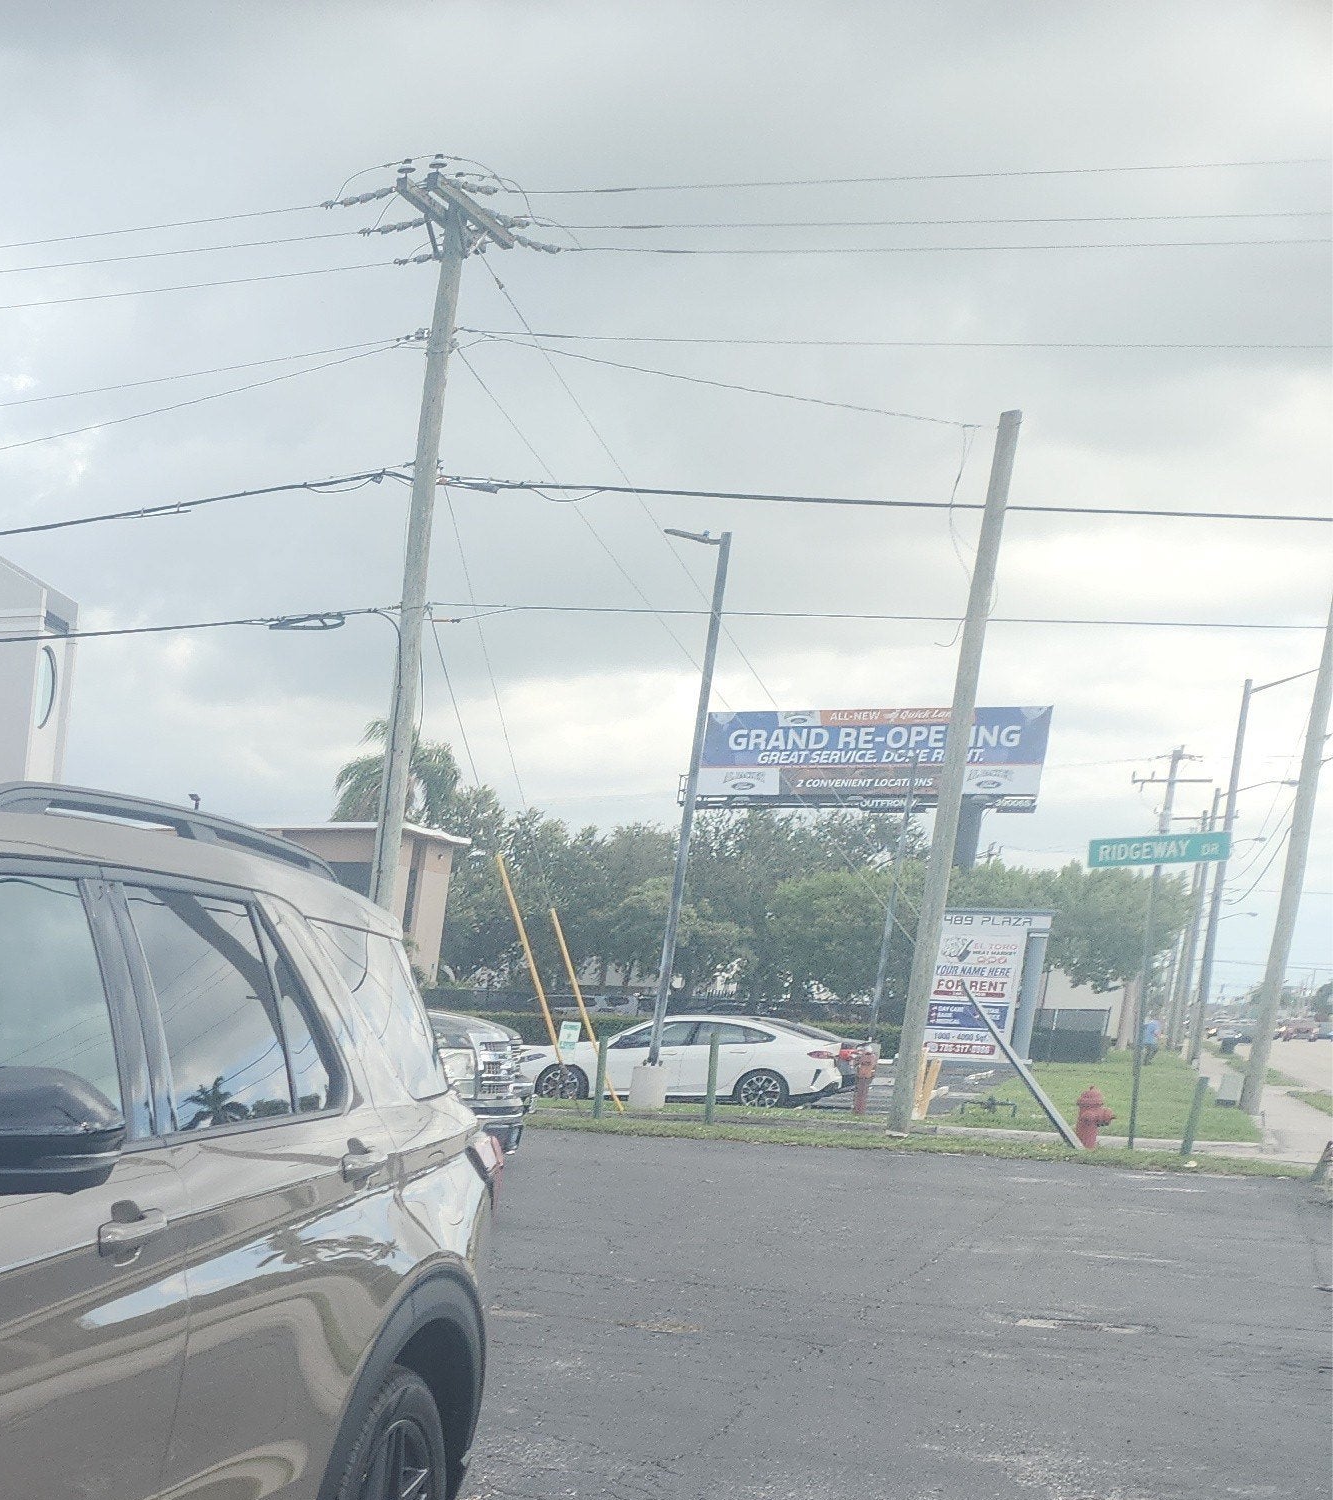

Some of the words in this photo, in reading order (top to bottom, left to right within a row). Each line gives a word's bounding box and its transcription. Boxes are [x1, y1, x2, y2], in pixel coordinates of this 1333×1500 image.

[729, 728, 829, 751] GRAND
[837, 725, 1022, 749] RE-OPEING
[757, 750, 809, 764] GREAT
[796, 779, 804, 787] 2
[805, 778, 873, 787] CONVENIENT
[874, 777, 933, 787] LOCATINS
[1098, 840, 1190, 862] RIDGEWAY
[981, 916, 1032, 926] PLAZA
[935, 965, 958, 975] YOUR
[960, 966, 987, 976] NAME
[988, 967, 1012, 977] HERE
[970, 980, 1007, 991] RENT
